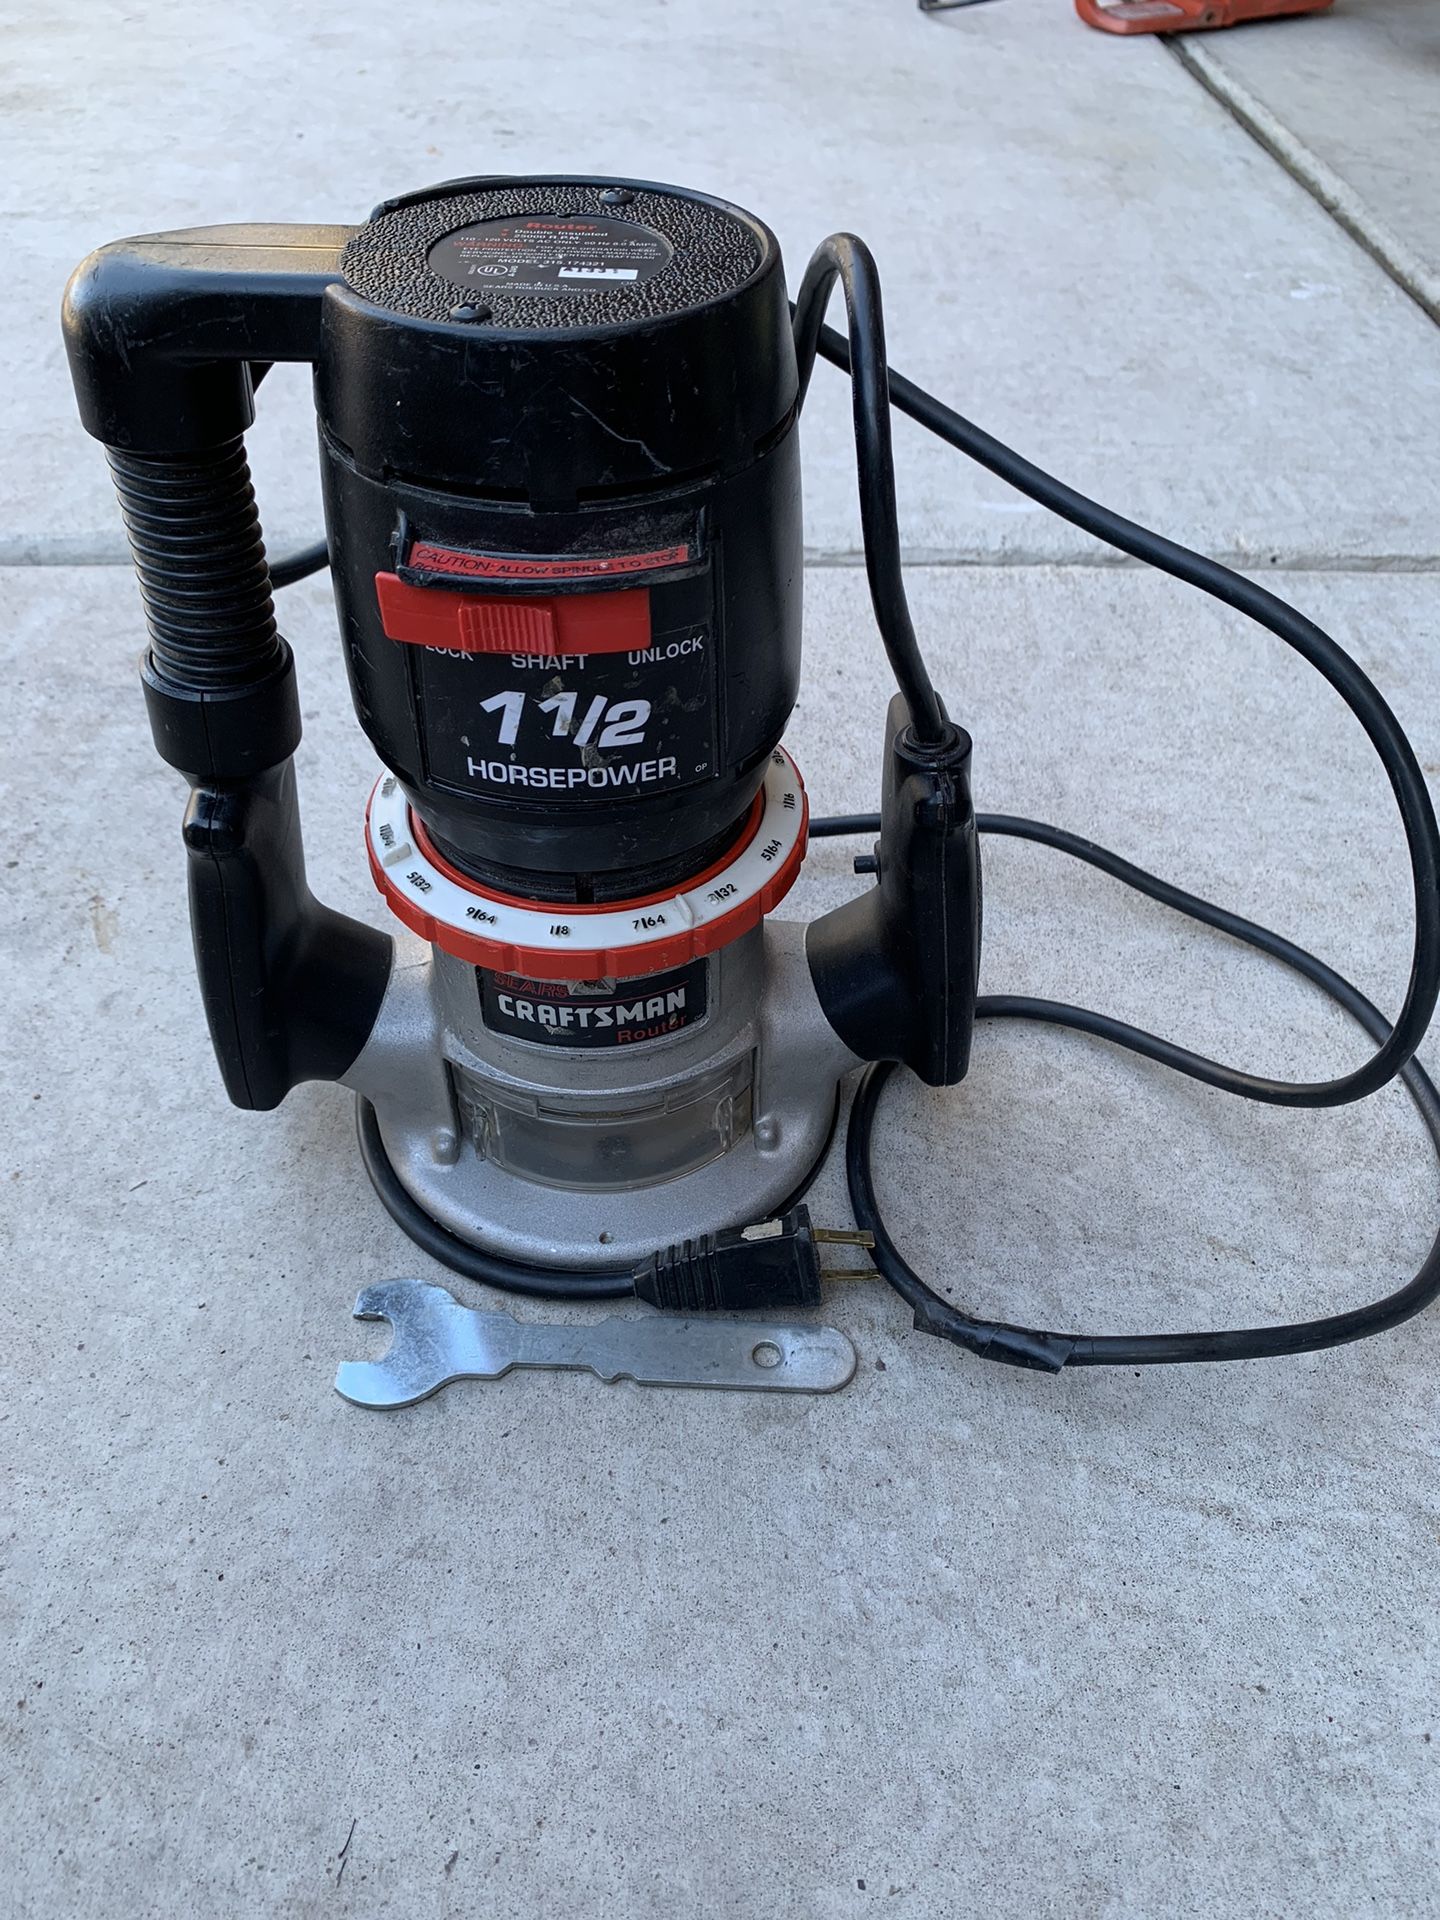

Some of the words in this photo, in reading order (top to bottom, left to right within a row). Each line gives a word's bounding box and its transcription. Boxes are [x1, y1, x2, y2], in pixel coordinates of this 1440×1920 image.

[526, 223, 597, 231] Router
[416, 549, 495, 571] CAUTION:
[496, 565, 549, 574] ALLOW
[644, 548, 678, 565] STOP
[511, 654, 588, 670] SHAFT
[628, 636, 704, 666] UNLOCK
[467, 757, 677, 788] HORSEPOWER
[494, 972, 569, 998] SEARS
[497, 987, 687, 1028] CRAFTSMAN
[617, 1013, 687, 1043] Router
